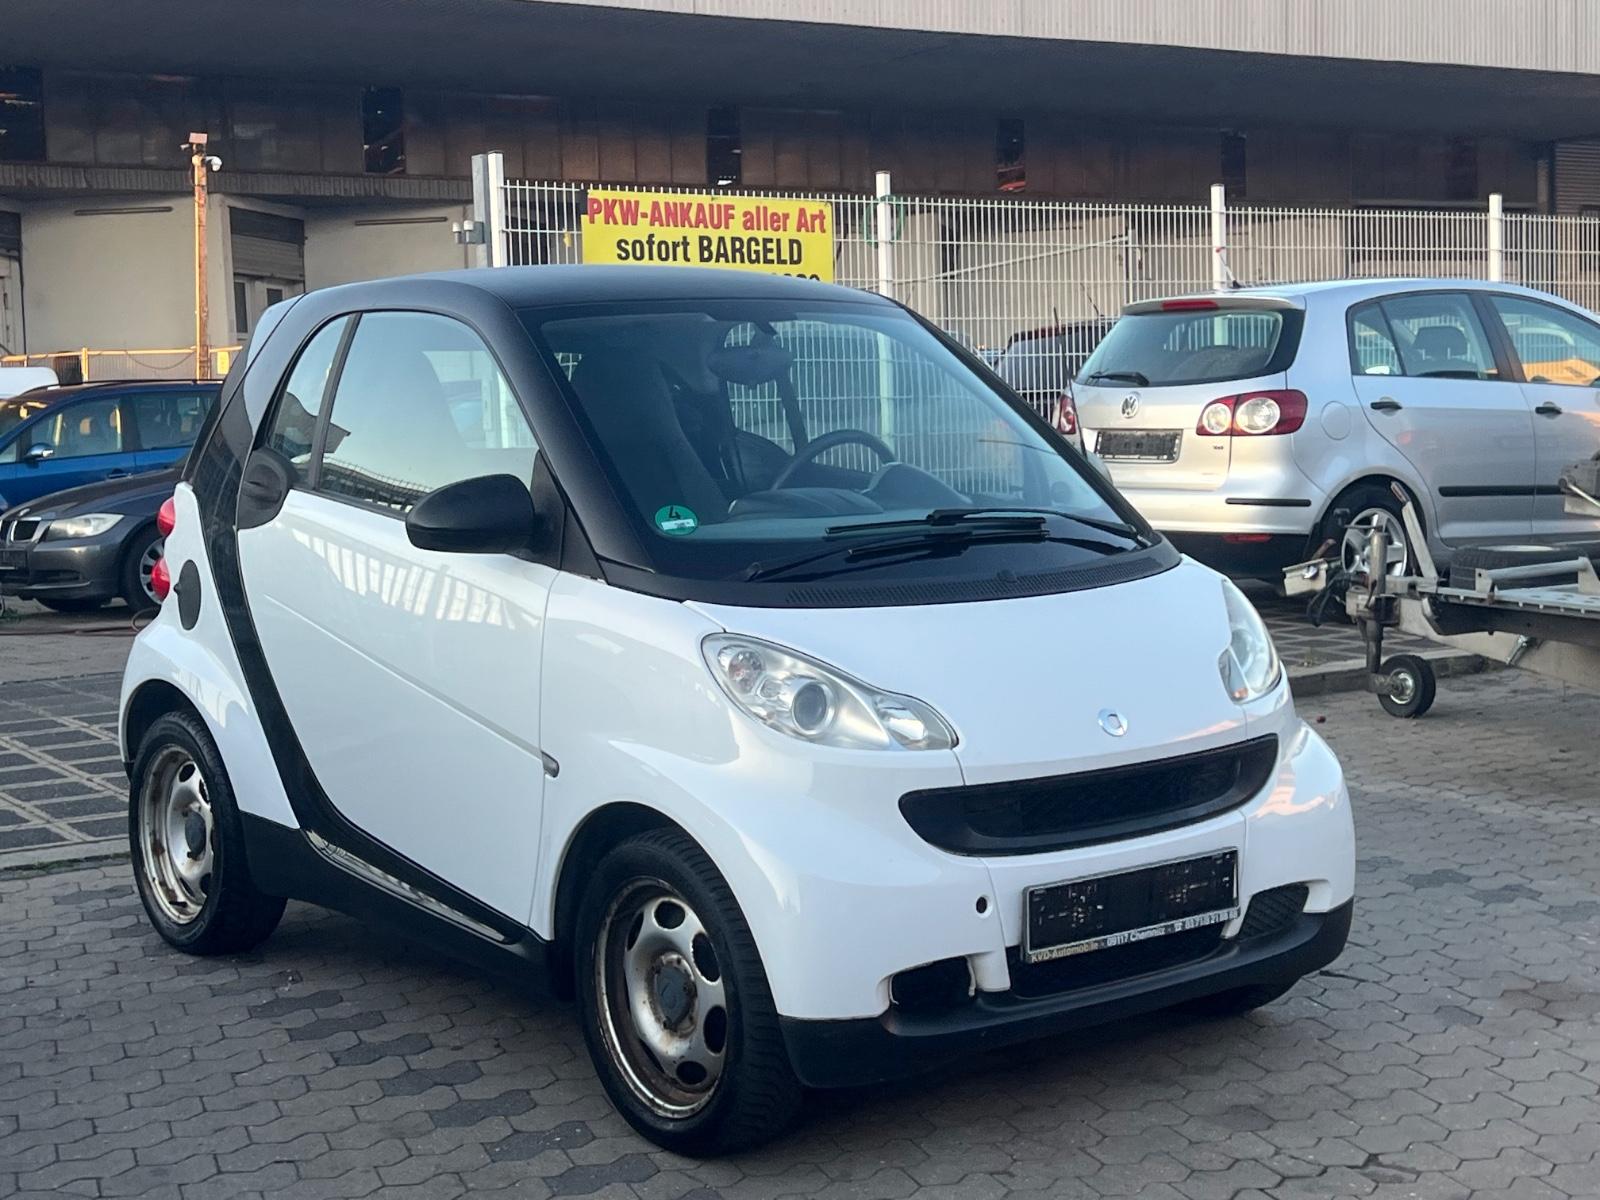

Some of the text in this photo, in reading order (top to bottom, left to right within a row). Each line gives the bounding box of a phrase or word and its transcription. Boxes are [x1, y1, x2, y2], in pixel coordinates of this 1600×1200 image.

[587, 198, 827, 234] PKW-ANKAUF aller Art
[616, 233, 803, 266] sofort BARGELD
[668, 504, 681, 519] 4
